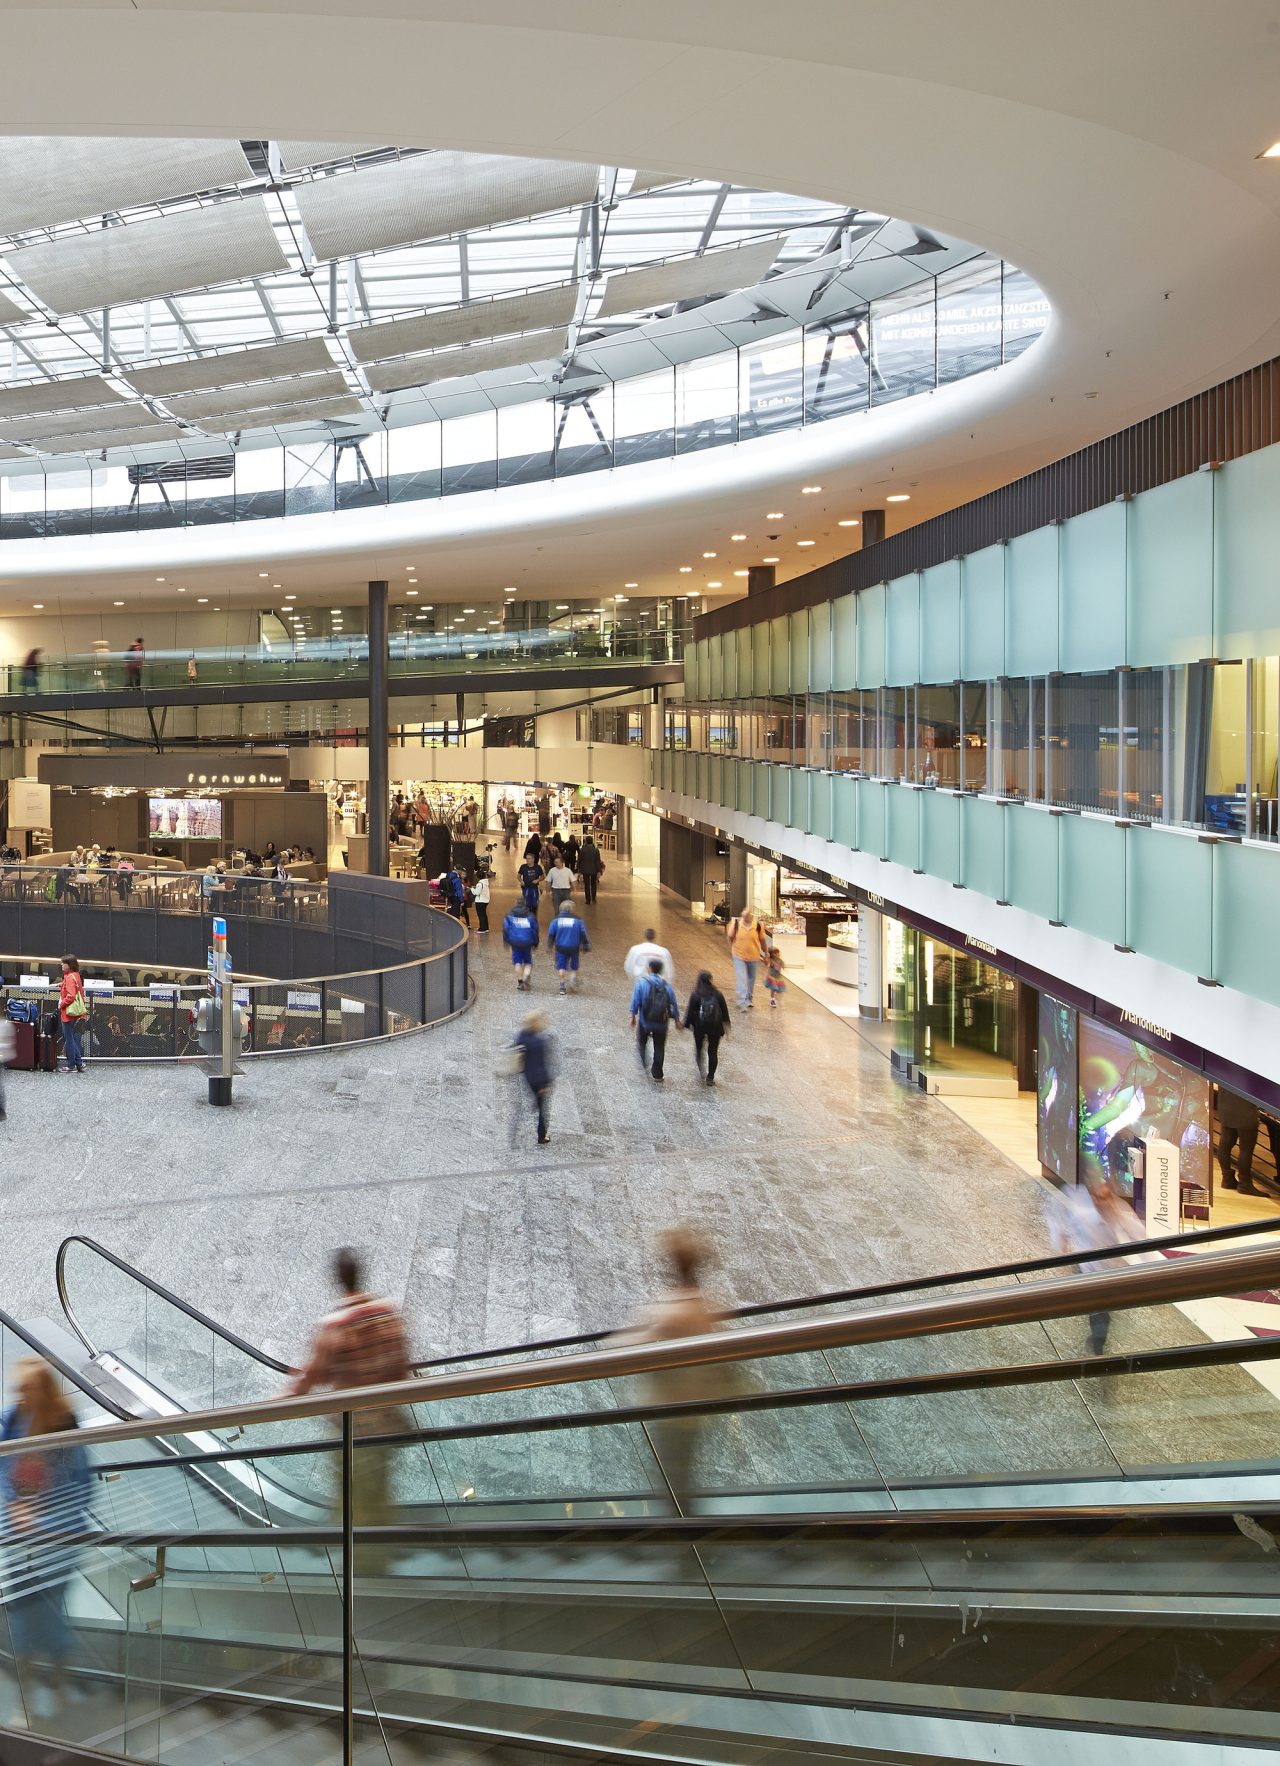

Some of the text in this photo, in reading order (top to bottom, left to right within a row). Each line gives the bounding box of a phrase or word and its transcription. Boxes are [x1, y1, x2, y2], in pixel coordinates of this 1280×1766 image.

[187, 773, 267, 784] fernweh
[1120, 1008, 1171, 1041] Marionnaud
[1153, 1157, 1172, 1230] Marionnaud
